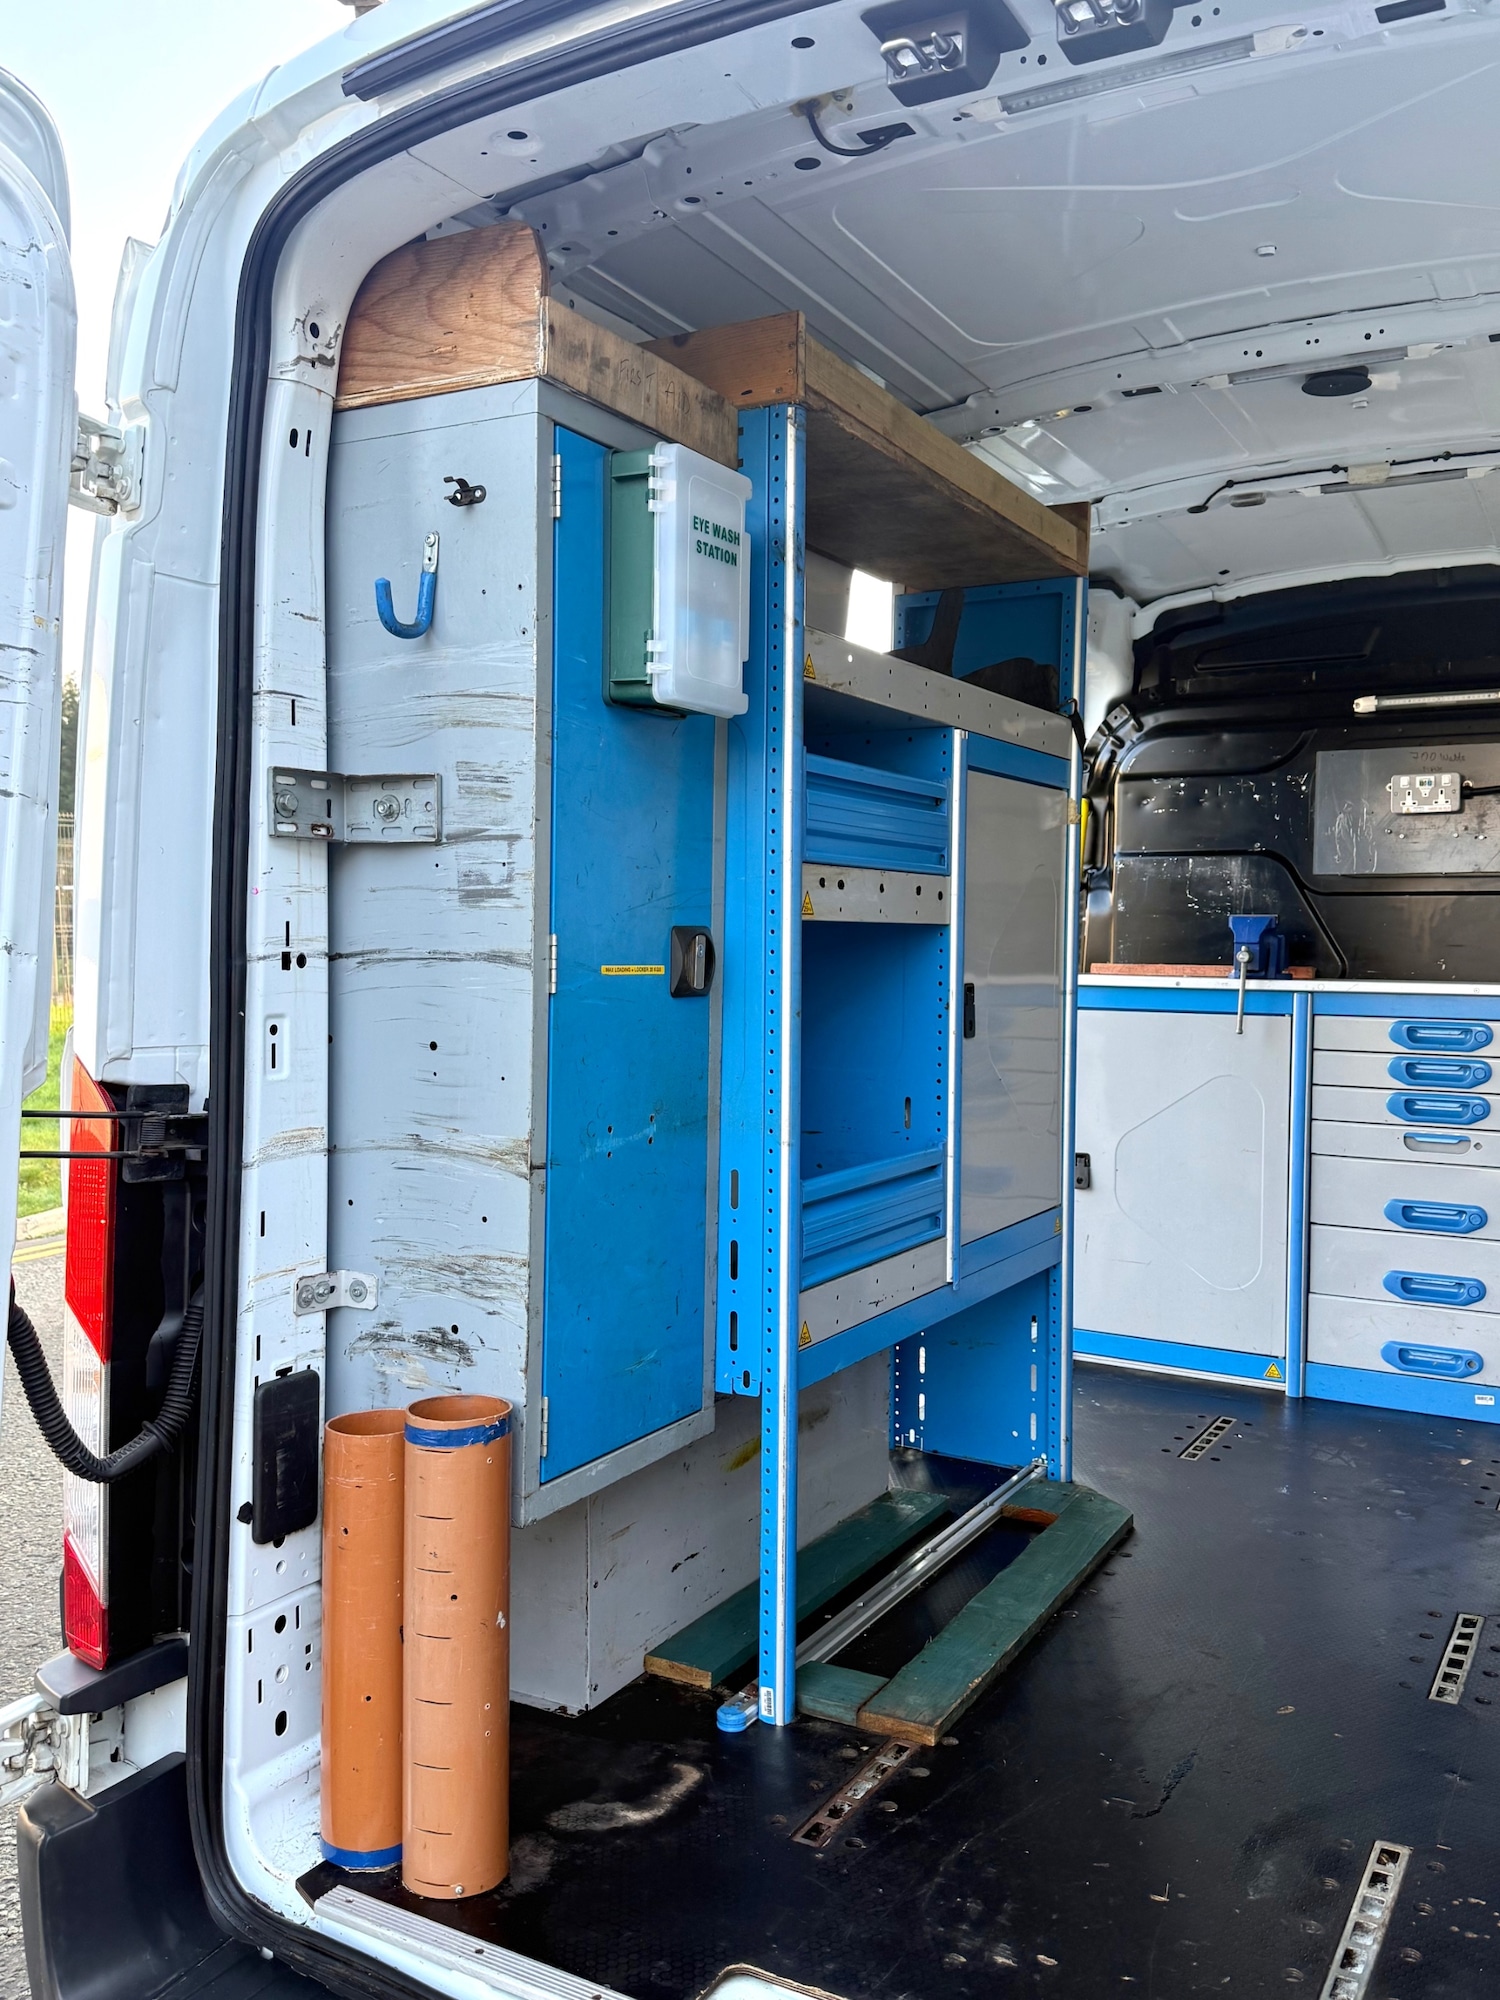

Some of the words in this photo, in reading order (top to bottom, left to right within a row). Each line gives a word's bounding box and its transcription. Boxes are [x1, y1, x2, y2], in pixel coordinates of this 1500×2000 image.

[619, 358, 656, 393] FIRST
[664, 380, 691, 415] AID
[693, 515, 710, 535] EYE
[712, 522, 740, 547] WASH
[696, 539, 737, 567] STATION
